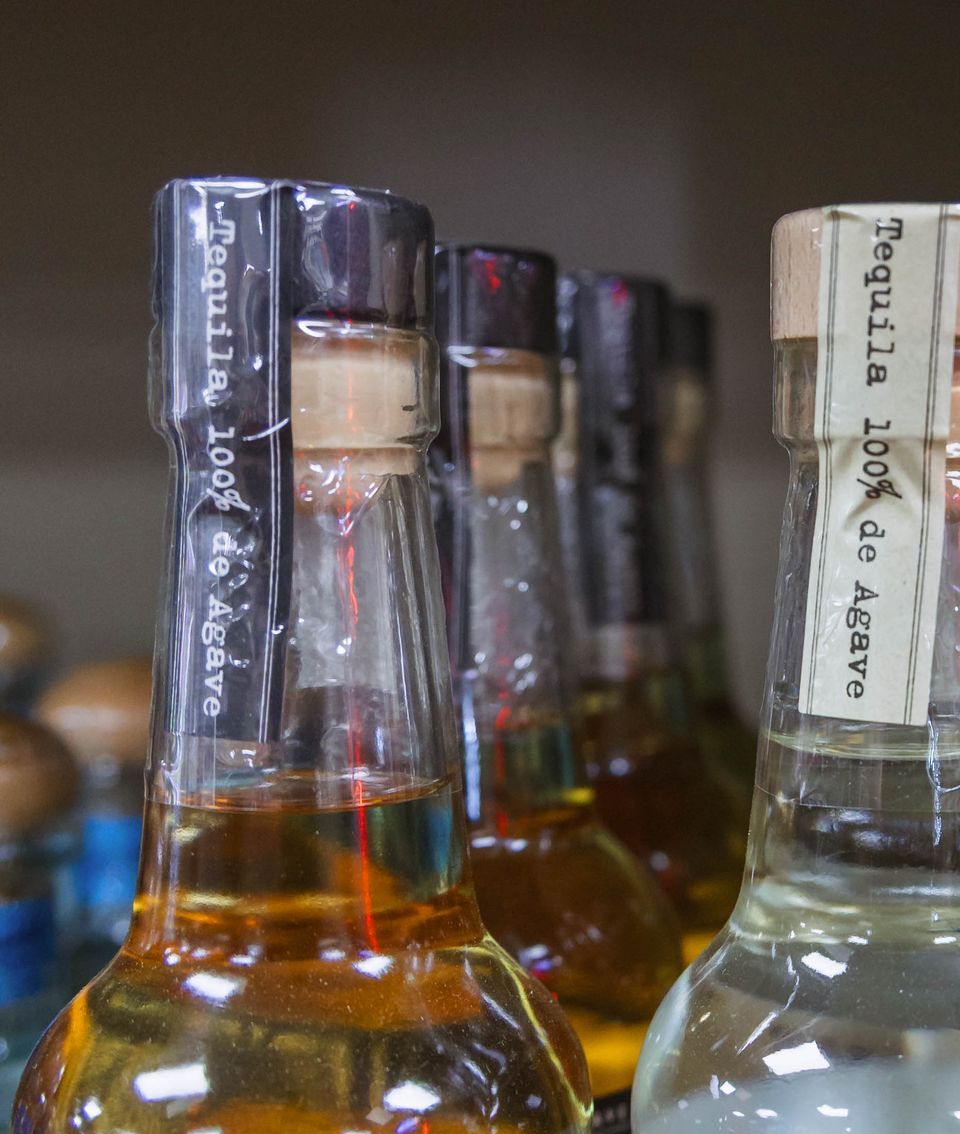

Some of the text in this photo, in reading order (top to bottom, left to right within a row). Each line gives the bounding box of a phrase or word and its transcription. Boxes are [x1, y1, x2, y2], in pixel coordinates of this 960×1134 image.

[201, 219, 251, 718] Tequila 100% de Agave
[845, 217, 904, 700] Tequila 100% de Agave
